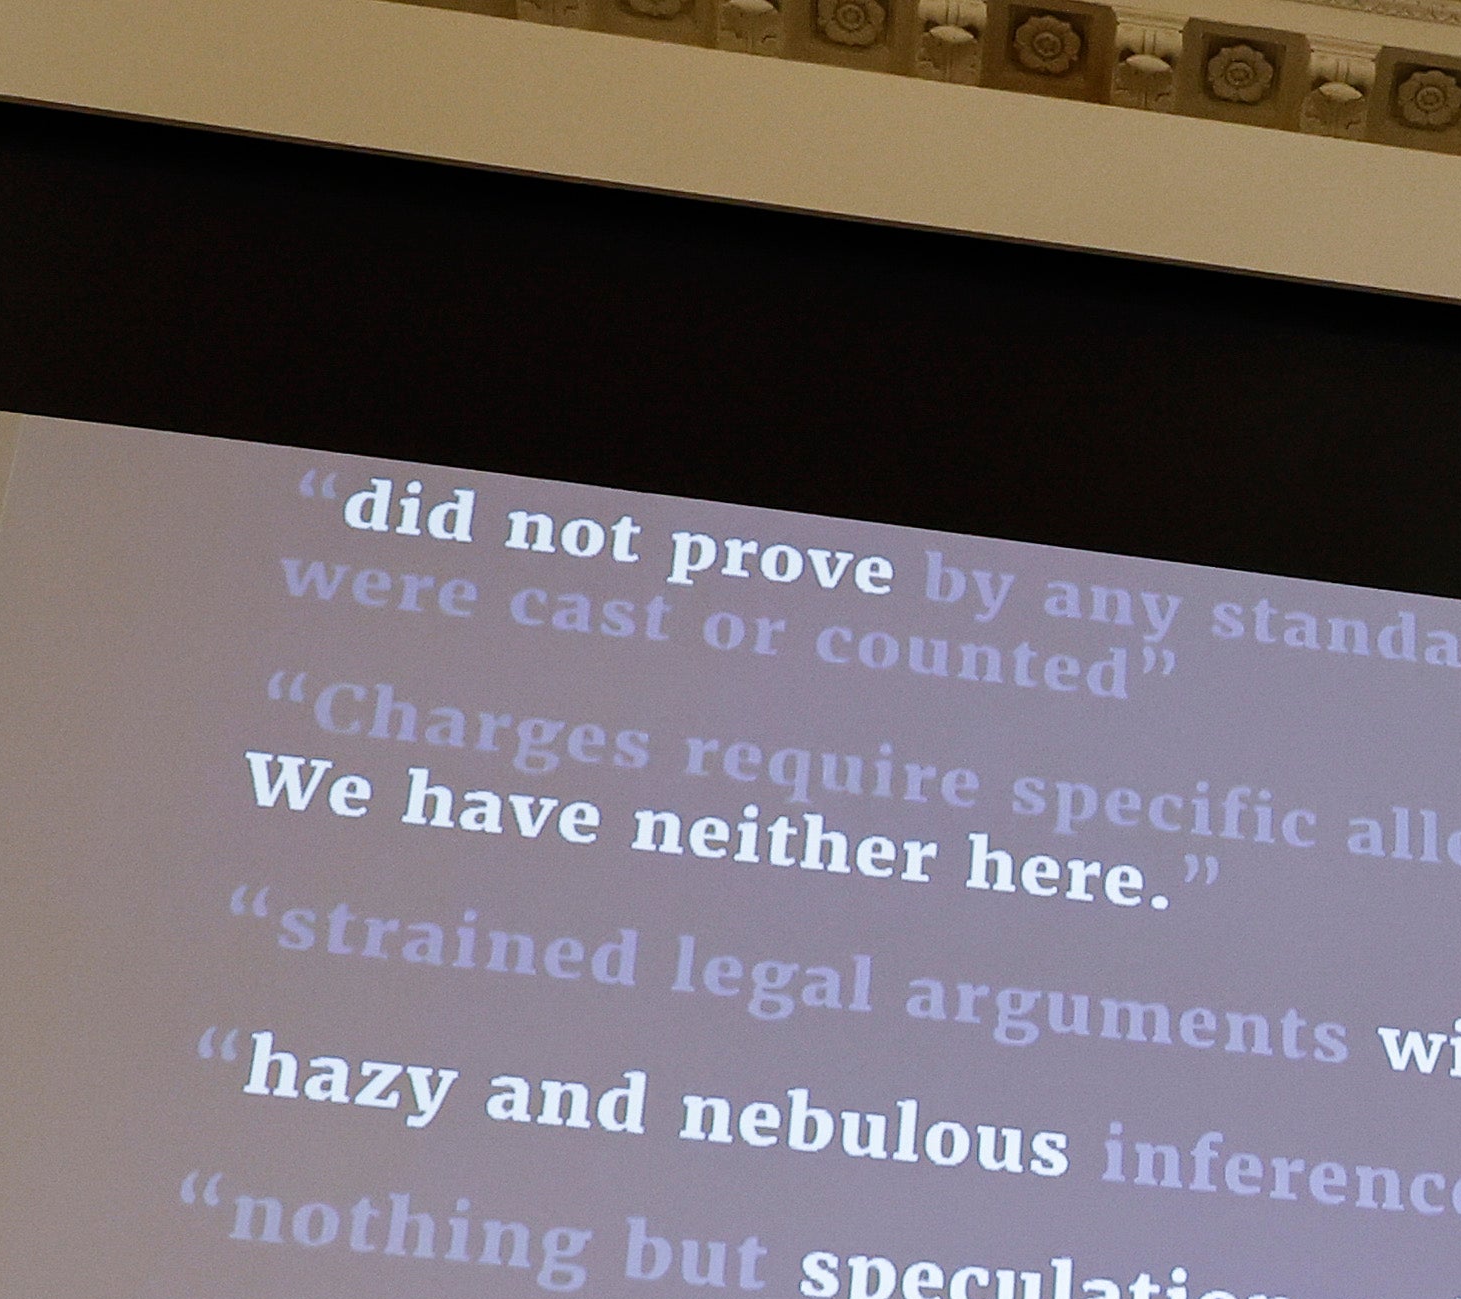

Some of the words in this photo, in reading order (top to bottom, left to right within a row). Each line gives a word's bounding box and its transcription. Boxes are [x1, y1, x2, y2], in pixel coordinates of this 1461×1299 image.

[279, 556, 479, 617] were
[509, 587, 670, 641] cast
[703, 611, 786, 655] or
[815, 625, 1176, 700] counted”
[297, 468, 477, 543] “did
[503, 508, 642, 564] not
[665, 529, 895, 595] prove
[925, 549, 1015, 622] by
[1044, 580, 1181, 643] any
[242, 748, 374, 818] We
[399, 765, 602, 844] have
[630, 802, 939, 883] neither
[964, 831, 1220, 911] here.”
[266, 669, 650, 774] “Charges
[685, 736, 980, 808] require
[1011, 776, 1316, 848] specific
[228, 884, 639, 987] “strained
[671, 933, 872, 1021] legal
[905, 977, 1349, 1064] arguments
[196, 1026, 460, 1129] “hazy
[485, 1068, 648, 1135] and
[677, 1085, 1069, 1177] nebulous
[178, 1171, 593, 1292] “nothing
[625, 1215, 768, 1290] but
